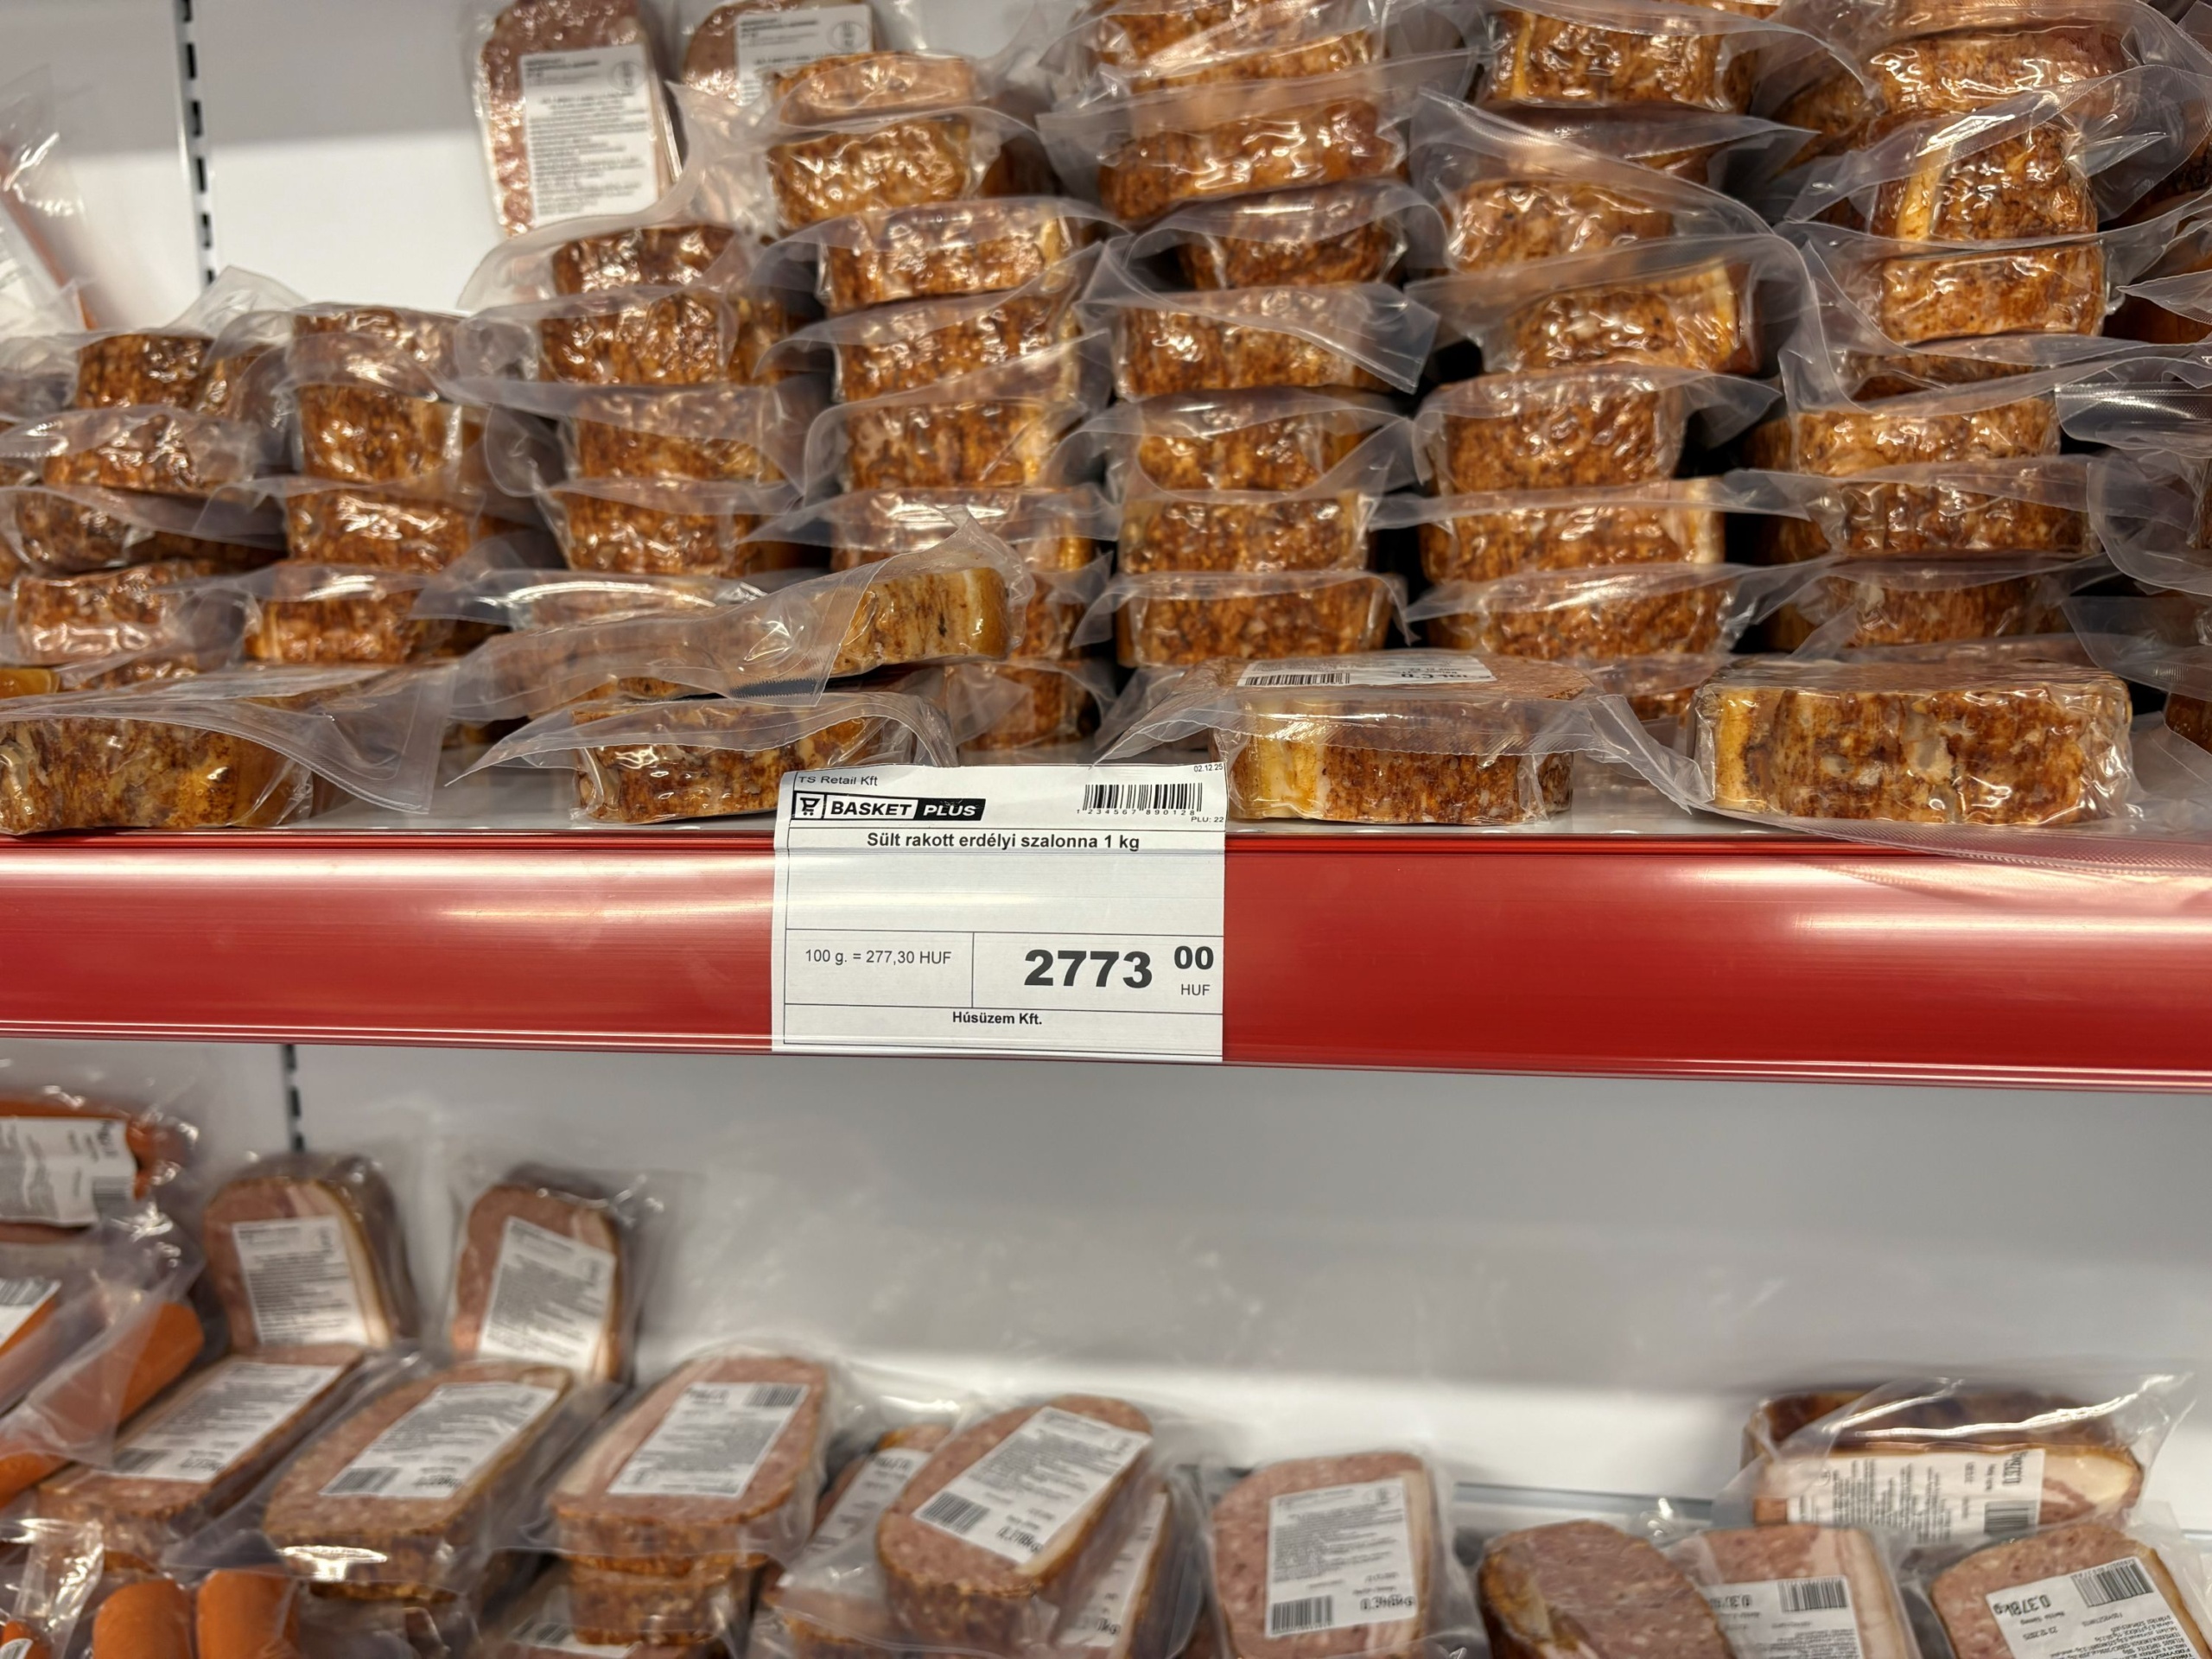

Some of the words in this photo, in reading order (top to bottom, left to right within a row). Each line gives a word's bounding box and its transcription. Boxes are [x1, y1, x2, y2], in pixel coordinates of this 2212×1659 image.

[1193, 764, 1224, 772] 02.12.25
[820, 775, 856, 785] Retail
[860, 775, 878, 786] Kft
[830, 801, 912, 816] BASKET
[923, 804, 976, 817] PLUS
[867, 832, 900, 847] Sült
[906, 832, 955, 847] rakott
[959, 832, 1015, 851] erdélyi
[1020, 833, 1098, 849] szalonna
[1104, 834, 1113, 849] 1
[1119, 834, 1140, 853] kg
[805, 949, 831, 963] 100
[835, 952, 848, 966] g.
[866, 950, 915, 966] 277,30
[919, 951, 952, 964] HUF
[1173, 945, 1214, 970] 00
[1023, 949, 1153, 989] 2773
[1180, 983, 1211, 996] HUF
[951, 1010, 1014, 1025] Húsüzem
[1019, 1011, 1042, 1026] Kft.
